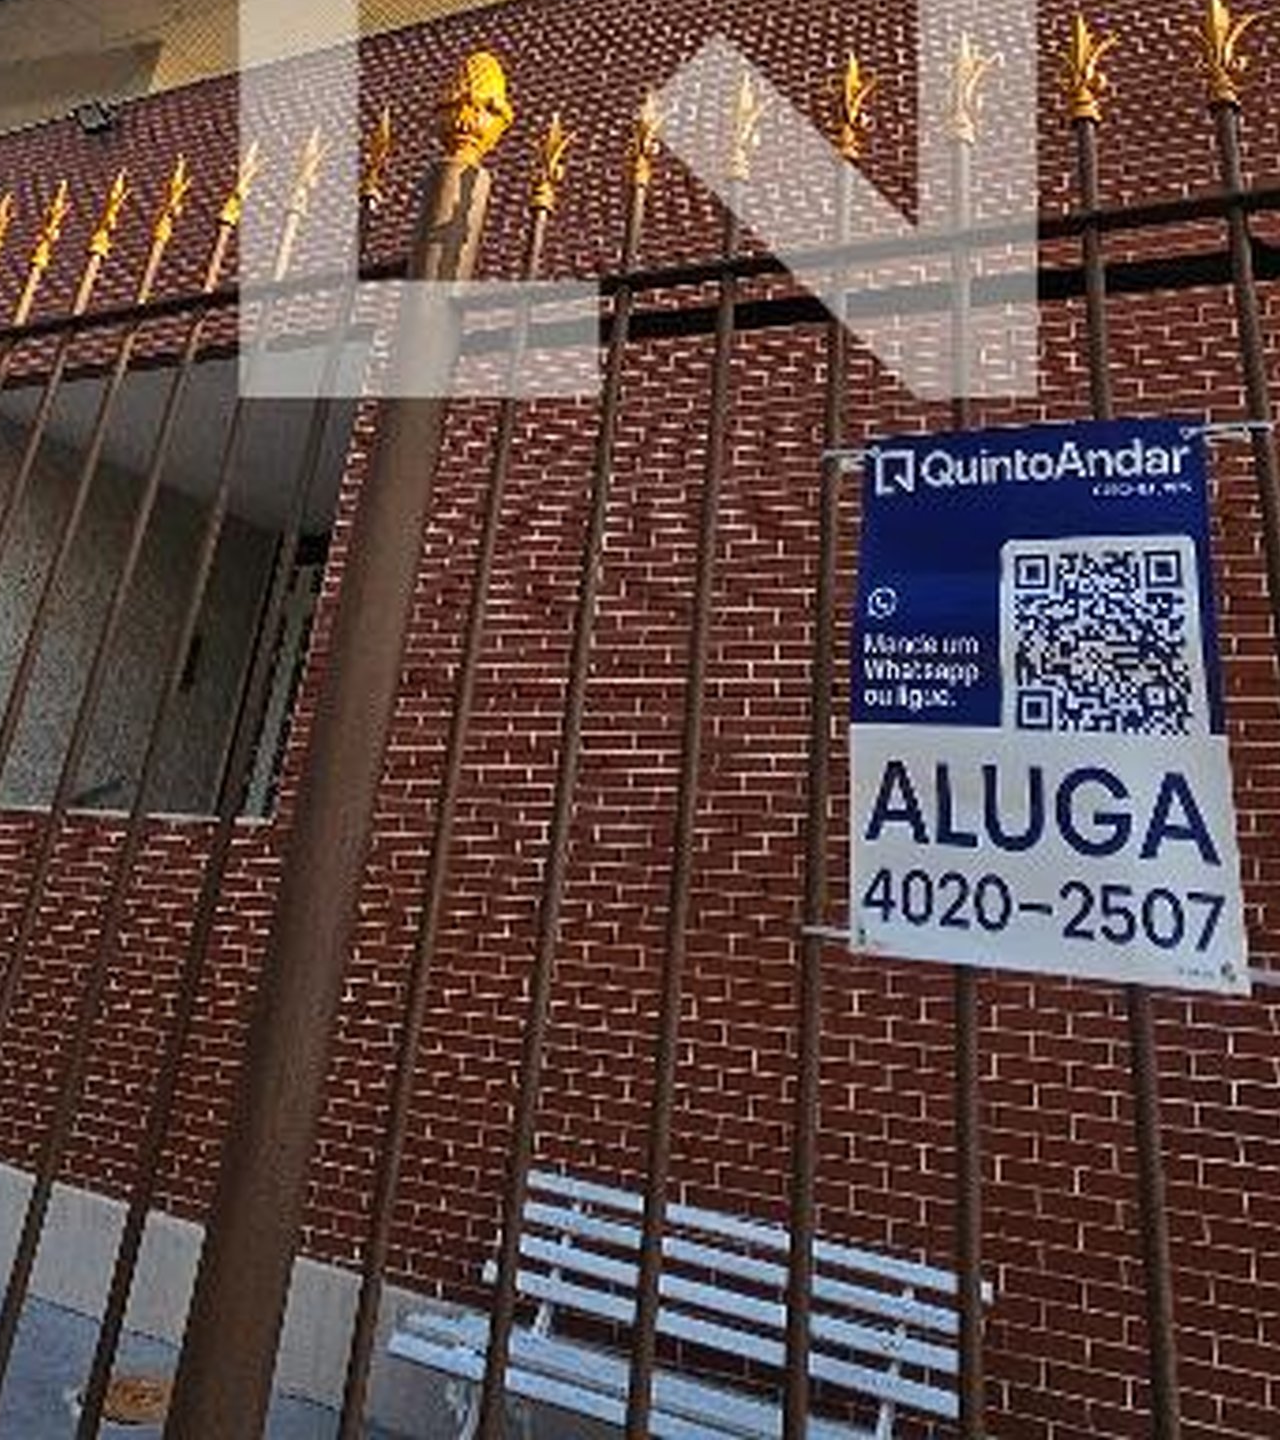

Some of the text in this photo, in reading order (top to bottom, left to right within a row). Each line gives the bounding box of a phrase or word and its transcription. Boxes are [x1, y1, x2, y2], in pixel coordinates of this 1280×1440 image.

[921, 438, 1191, 487] QuintoAndar
[942, 636, 979, 654] um
[863, 689, 893, 707] ou
[864, 760, 1222, 866] ALUGA
[863, 868, 1226, 952] 4020-2507
